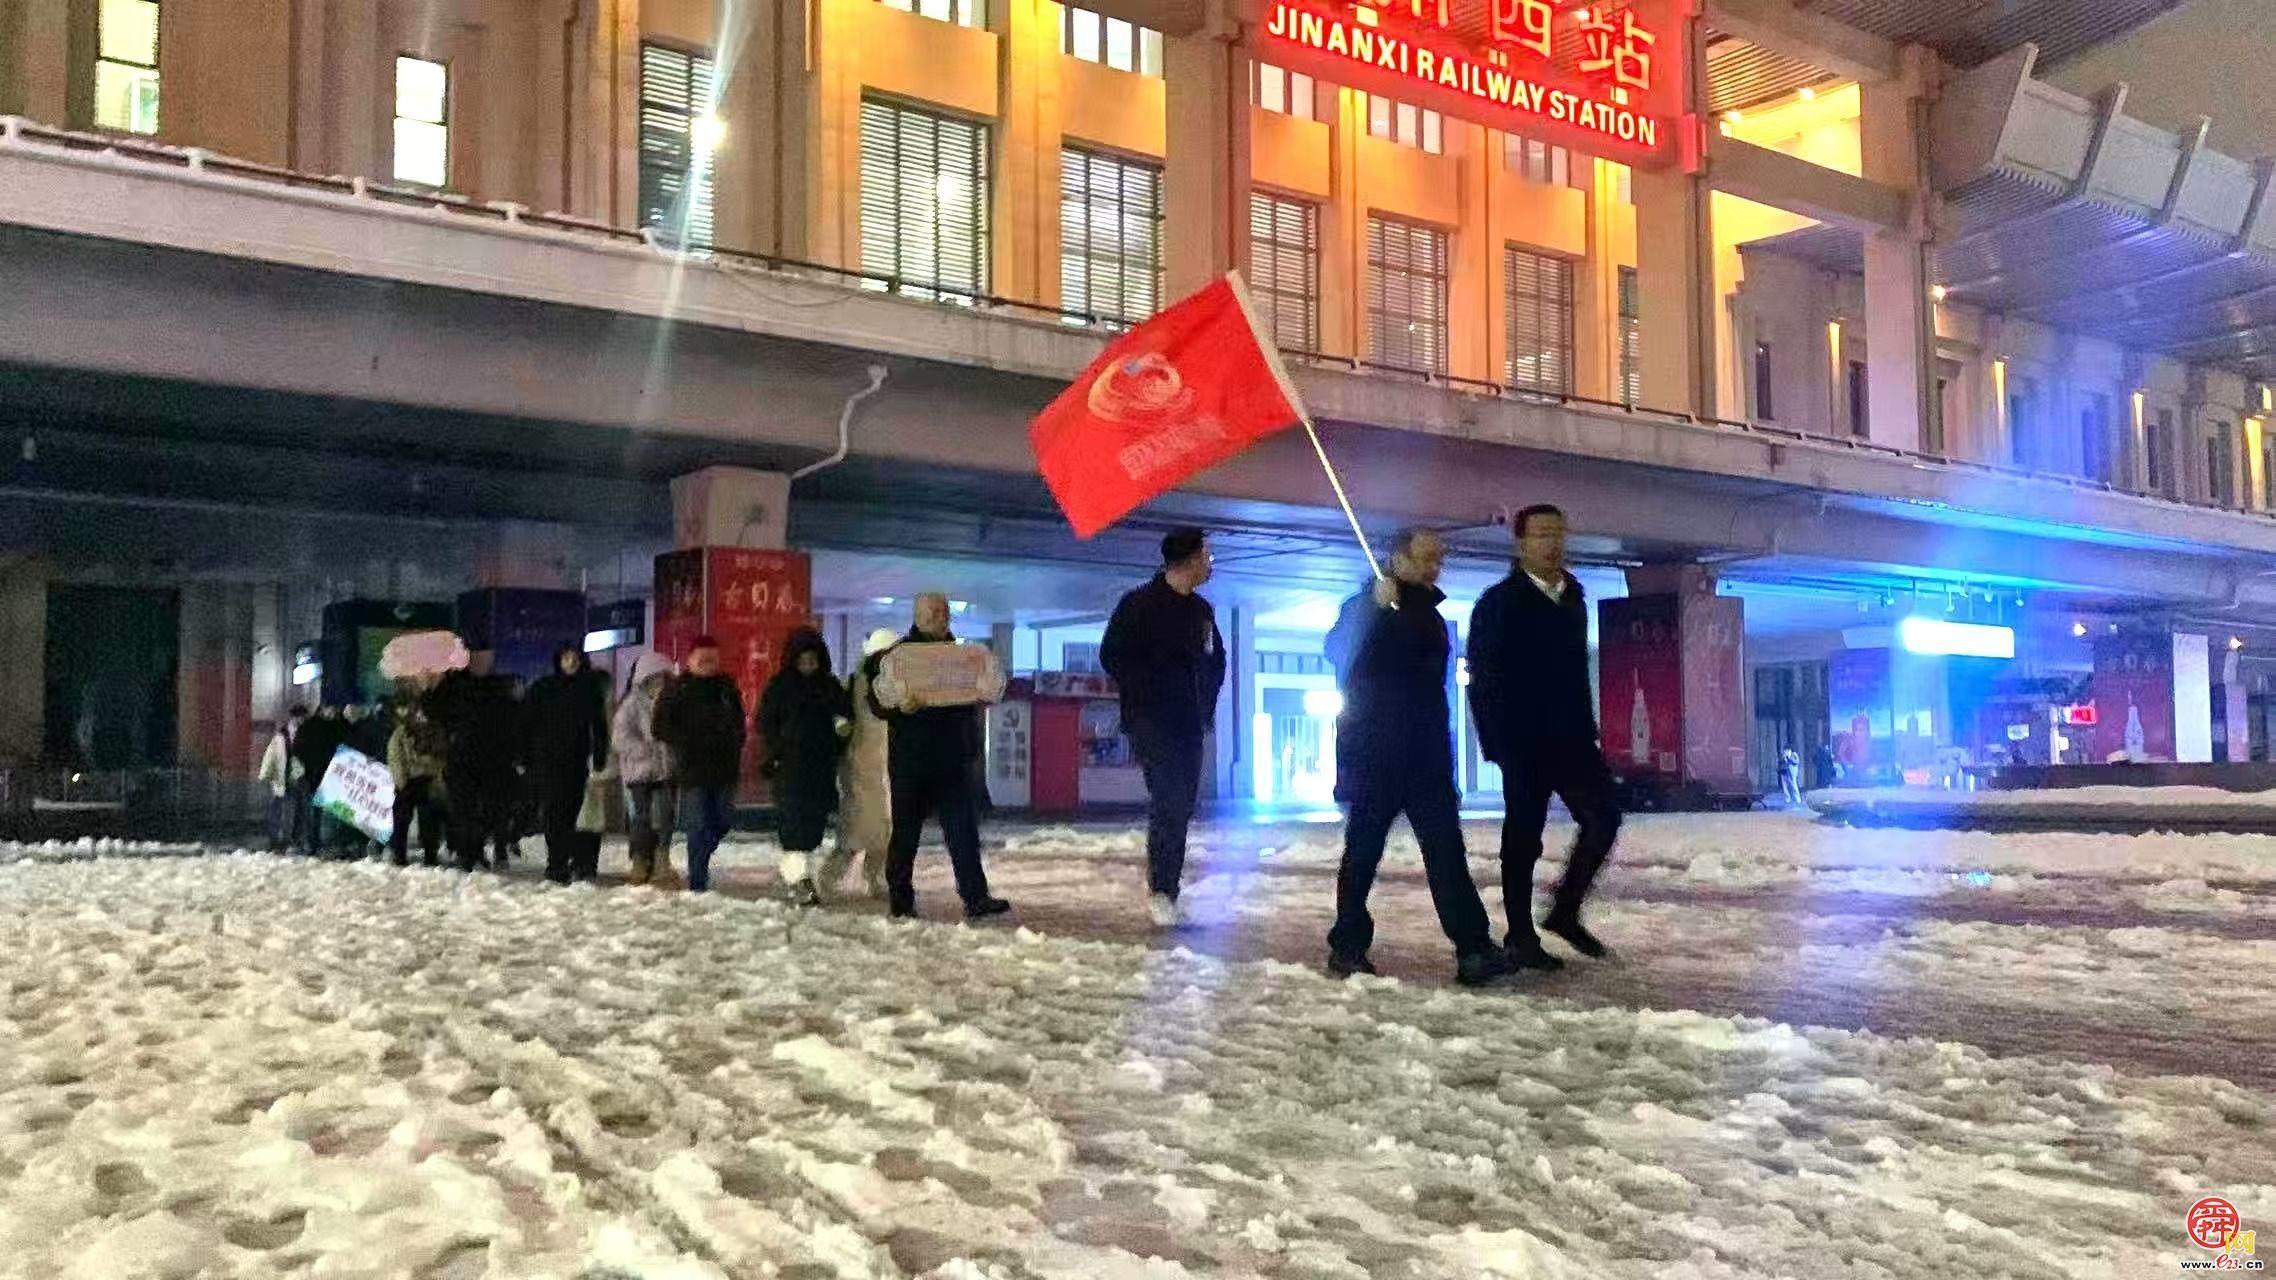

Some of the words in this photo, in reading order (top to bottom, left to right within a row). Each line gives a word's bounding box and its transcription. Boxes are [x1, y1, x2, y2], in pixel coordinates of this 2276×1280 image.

[1268, 5, 1408, 74] JINANXI
[1417, 48, 1545, 113] RAILWAY
[1549, 90, 1656, 147] STATION
